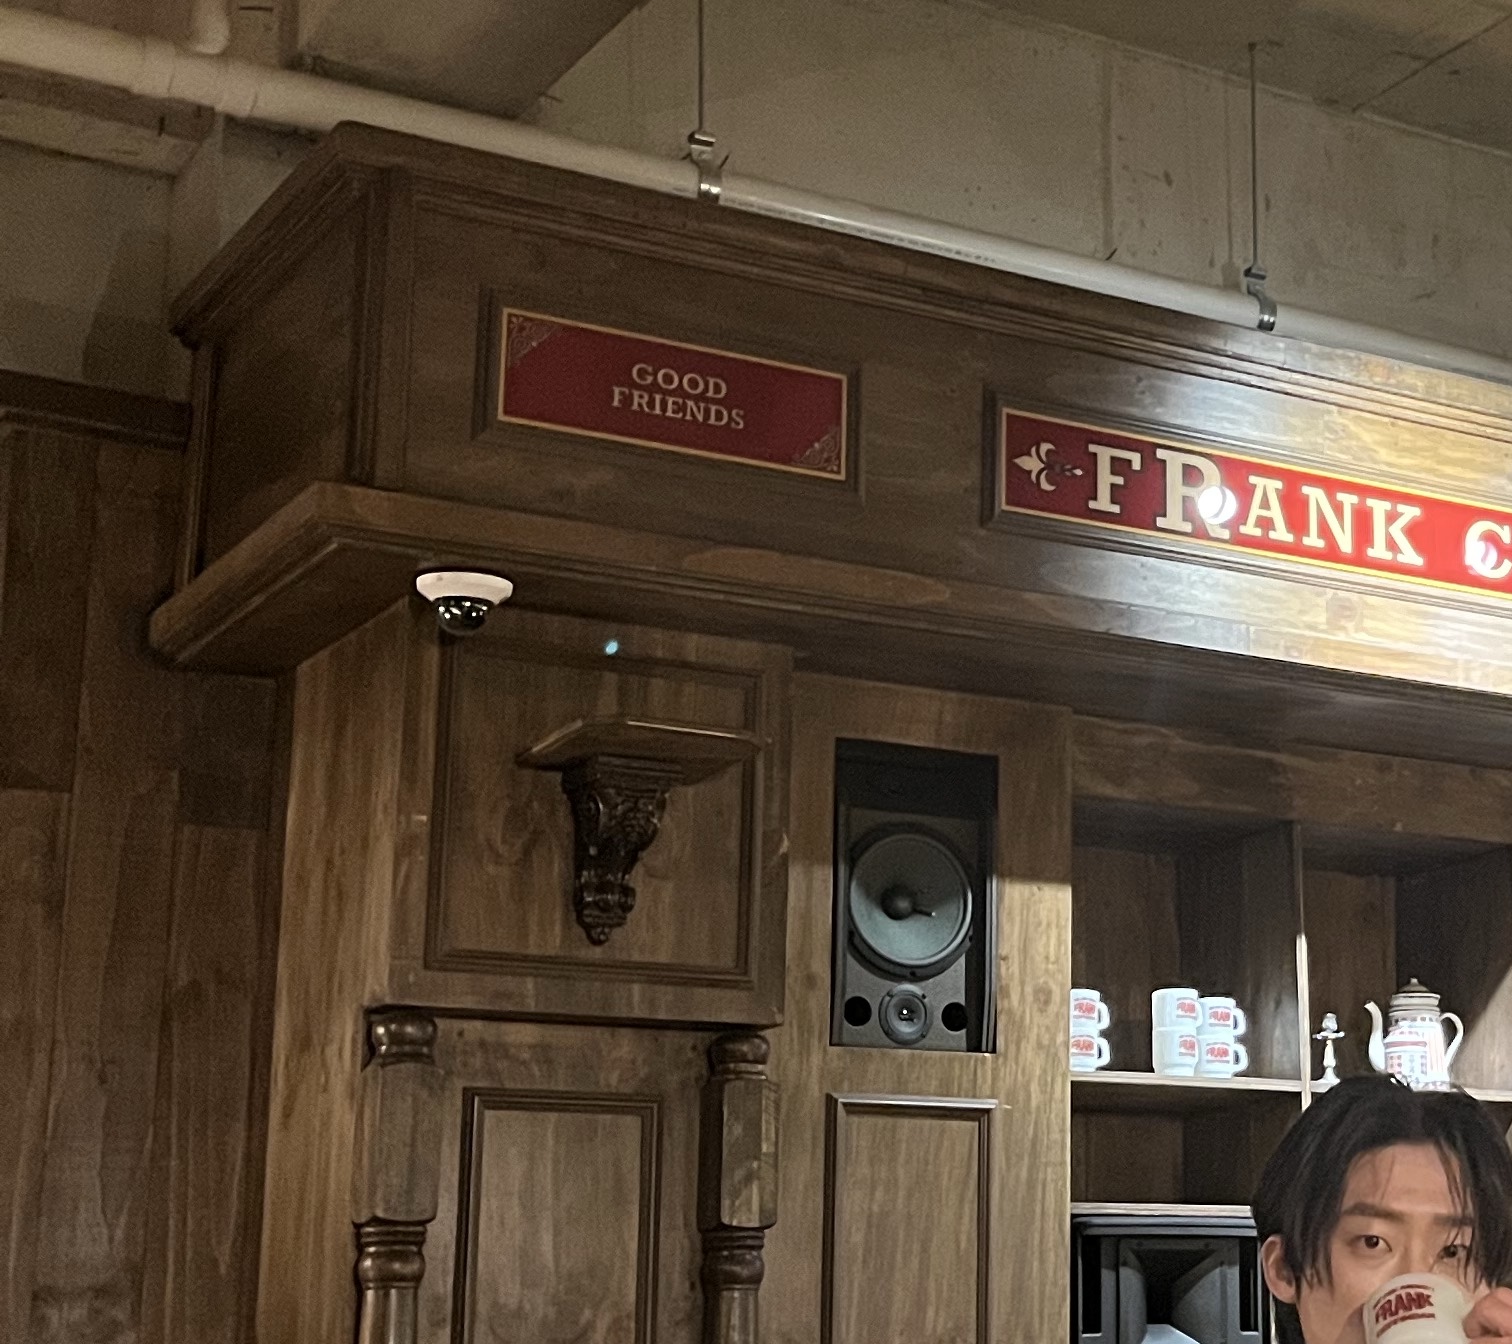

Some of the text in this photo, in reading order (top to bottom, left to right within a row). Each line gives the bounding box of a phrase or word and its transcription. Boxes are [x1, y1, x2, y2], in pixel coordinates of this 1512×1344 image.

[631, 362, 729, 400] GOOD
[611, 386, 746, 431] FRIENDS
[1086, 441, 1425, 567] FRANK
[1374, 1290, 1435, 1325] FRANK
